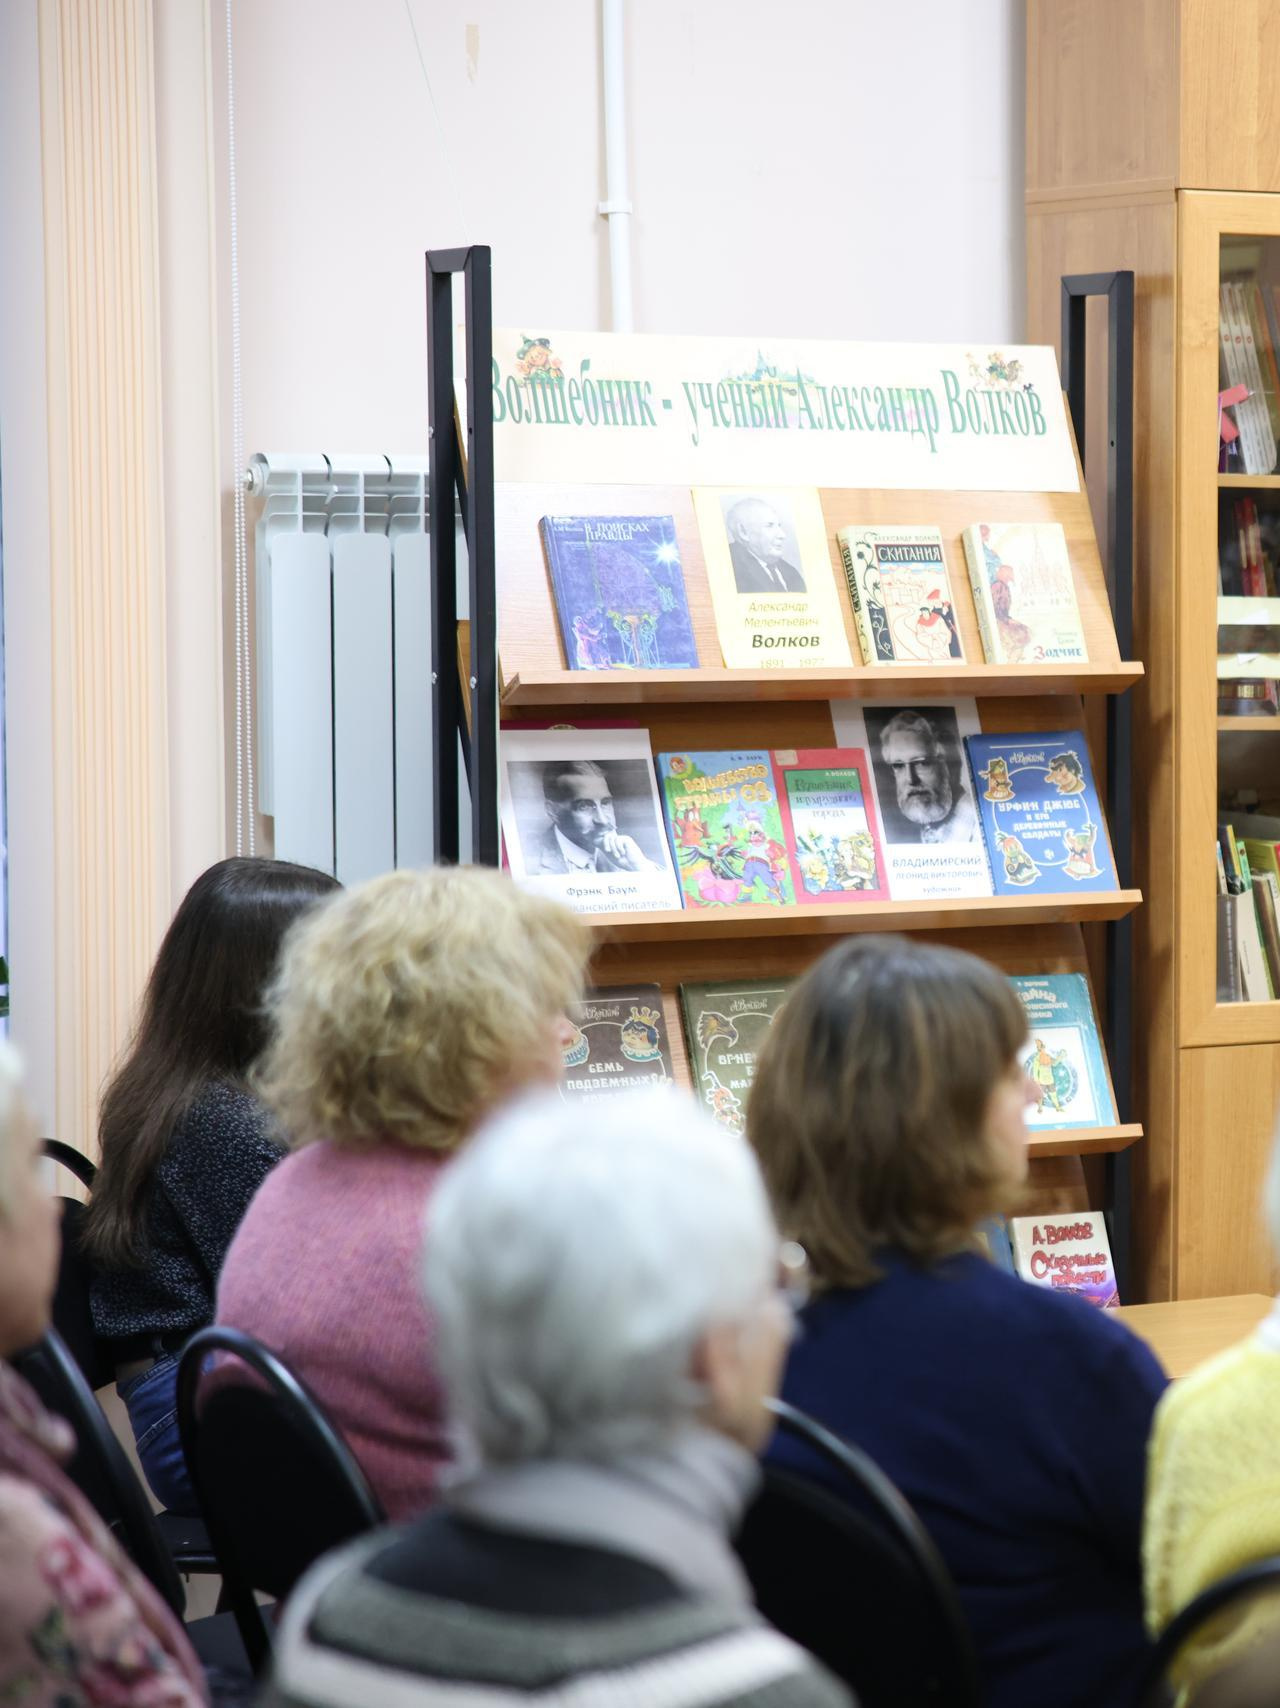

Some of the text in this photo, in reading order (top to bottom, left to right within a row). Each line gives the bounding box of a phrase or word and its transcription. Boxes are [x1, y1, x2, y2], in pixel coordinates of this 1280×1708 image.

[492, 357, 657, 427] Волшебник
[682, 365, 790, 447] ученый
[796, 366, 940, 454] Александр
[939, 369, 1048, 437] Волков
[877, 546, 942, 561] СКИТАНИЯ
[842, 546, 861, 612] СКИТАНИЯ
[748, 601, 809, 613] Александр
[744, 616, 820, 628] Мелентьевич
[751, 633, 821, 649] Волков
[997, 799, 1081, 813] УРФИН ДЖЮС
[1034, 812, 1050, 821] ЕГО
[1013, 820, 1068, 833] ДЕРЕВЯННЫЕ
[1021, 829, 1062, 841] СОЛДАТЫ
[892, 855, 983, 868] ВЛАДИМИРСКИЙ
[895, 871, 930, 881] ЛЕОНИД
[566, 885, 638, 898] Фрэнк Баум
[620, 901, 672, 912] писатель
[588, 1062, 625, 1074] СЕМЬ
[567, 1074, 652, 1092] ПОДЗЕМНЫХ
